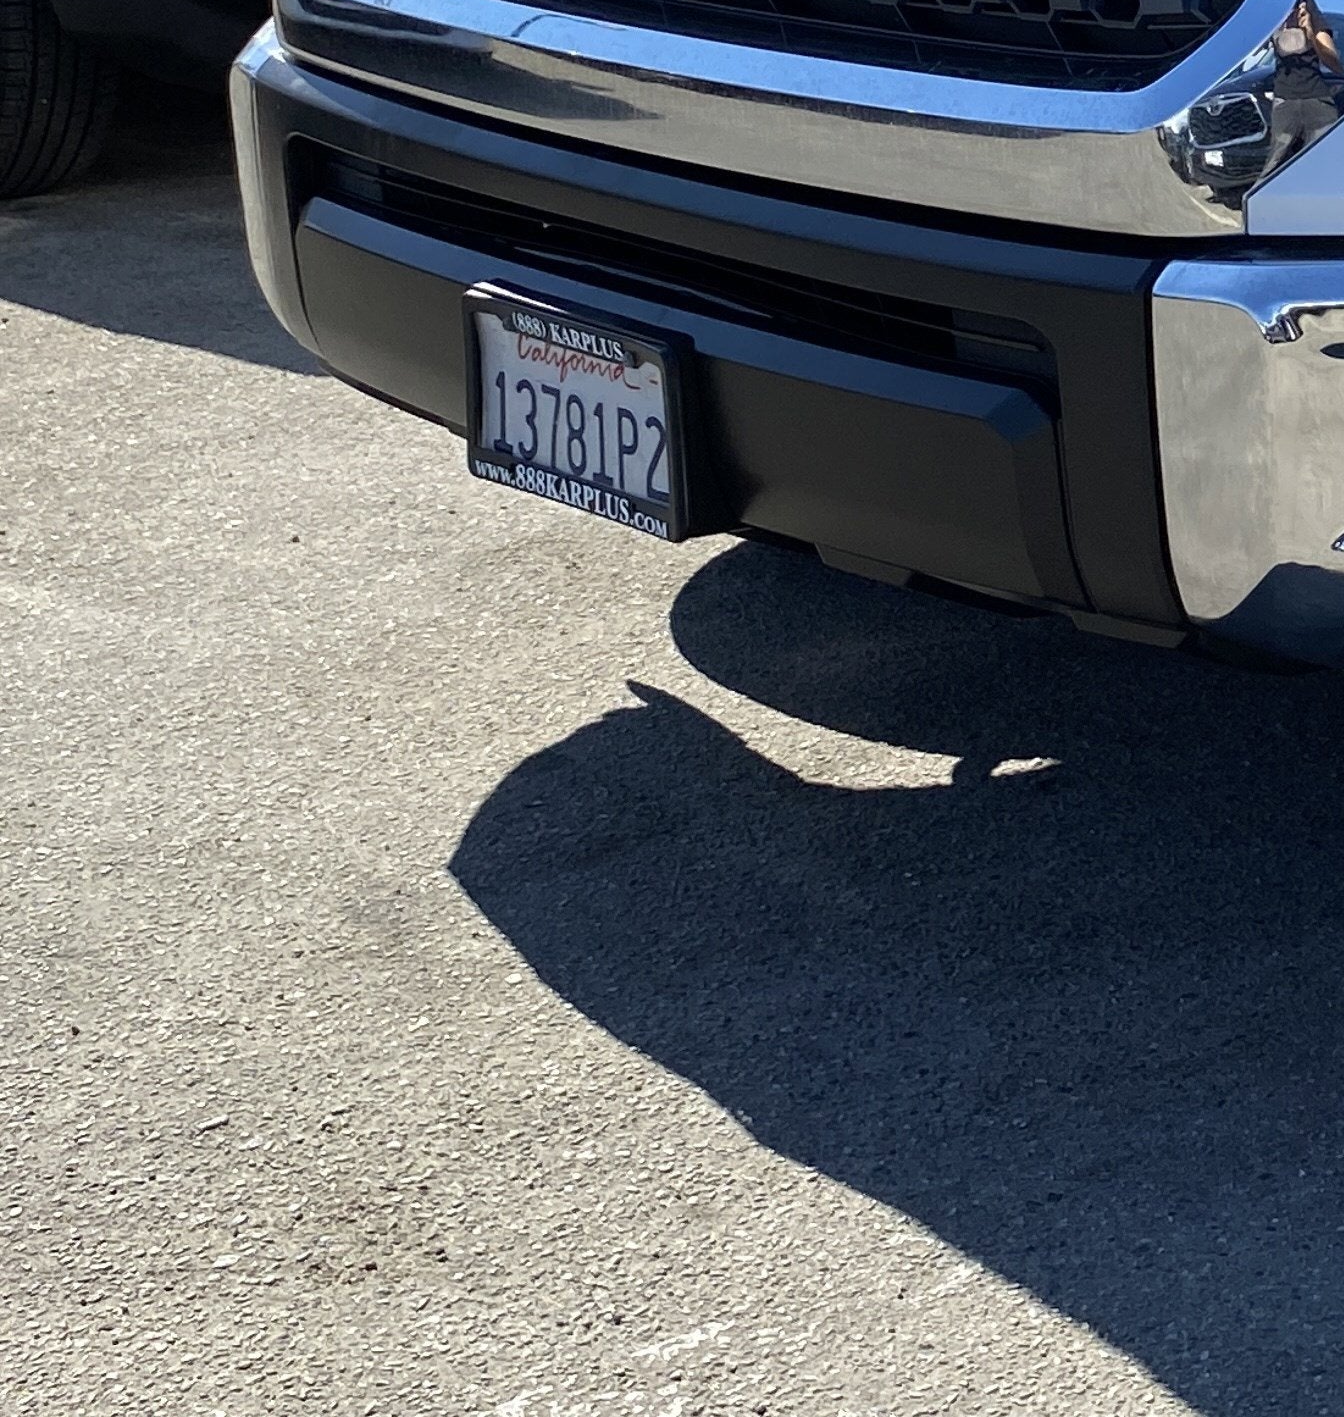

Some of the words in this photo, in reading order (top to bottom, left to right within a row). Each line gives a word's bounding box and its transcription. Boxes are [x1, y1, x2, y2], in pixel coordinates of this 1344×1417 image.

[512, 312, 547, 337] (888)
[550, 323, 624, 361] KARPLUS
[517, 333, 632, 386] California
[493, 371, 670, 500] 13781P2
